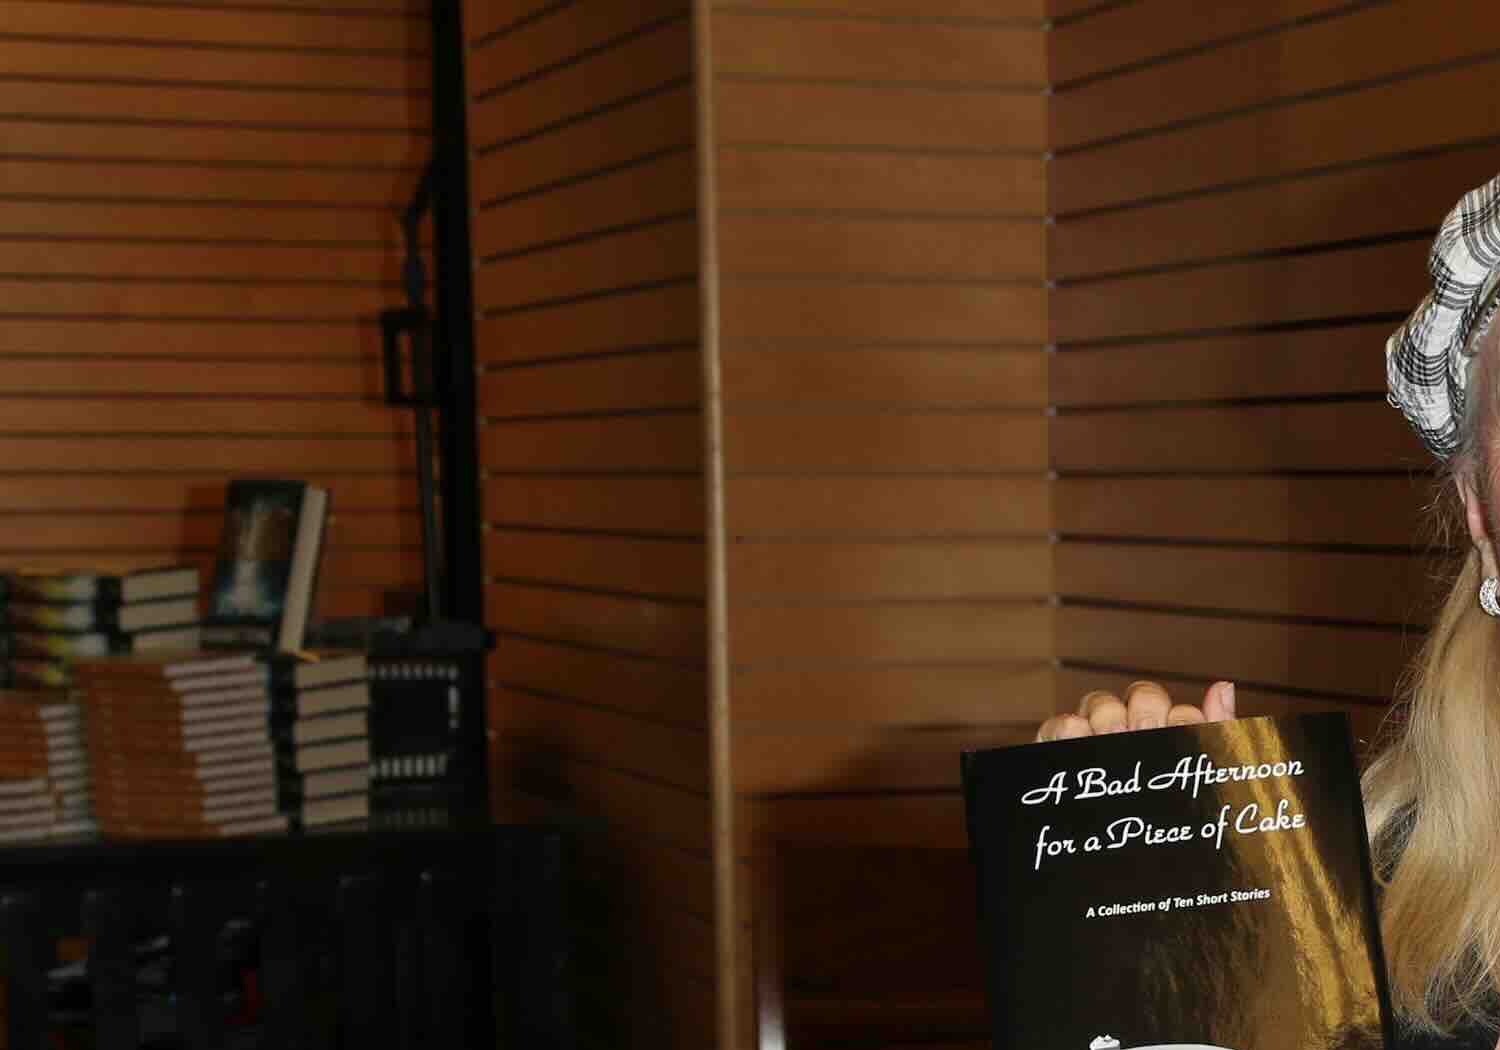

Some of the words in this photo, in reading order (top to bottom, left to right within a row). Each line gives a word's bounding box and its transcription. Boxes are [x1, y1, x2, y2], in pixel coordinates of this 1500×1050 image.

[1021, 771, 1068, 805] A
[1074, 761, 1142, 800] Bad
[1148, 754, 1305, 799] Afternoon
[1035, 825, 1077, 871] for
[1083, 835, 1102, 852] a
[1106, 816, 1194, 849] Piece
[1201, 804, 1231, 850] of
[1235, 800, 1306, 834] Cake
[1085, 907, 1096, 919] A
[1098, 900, 1156, 917] Collection
[1158, 898, 1171, 912] of
[1173, 897, 1194, 909] Ten
[1196, 892, 1228, 906] Short
[1230, 887, 1271, 902] Stories
